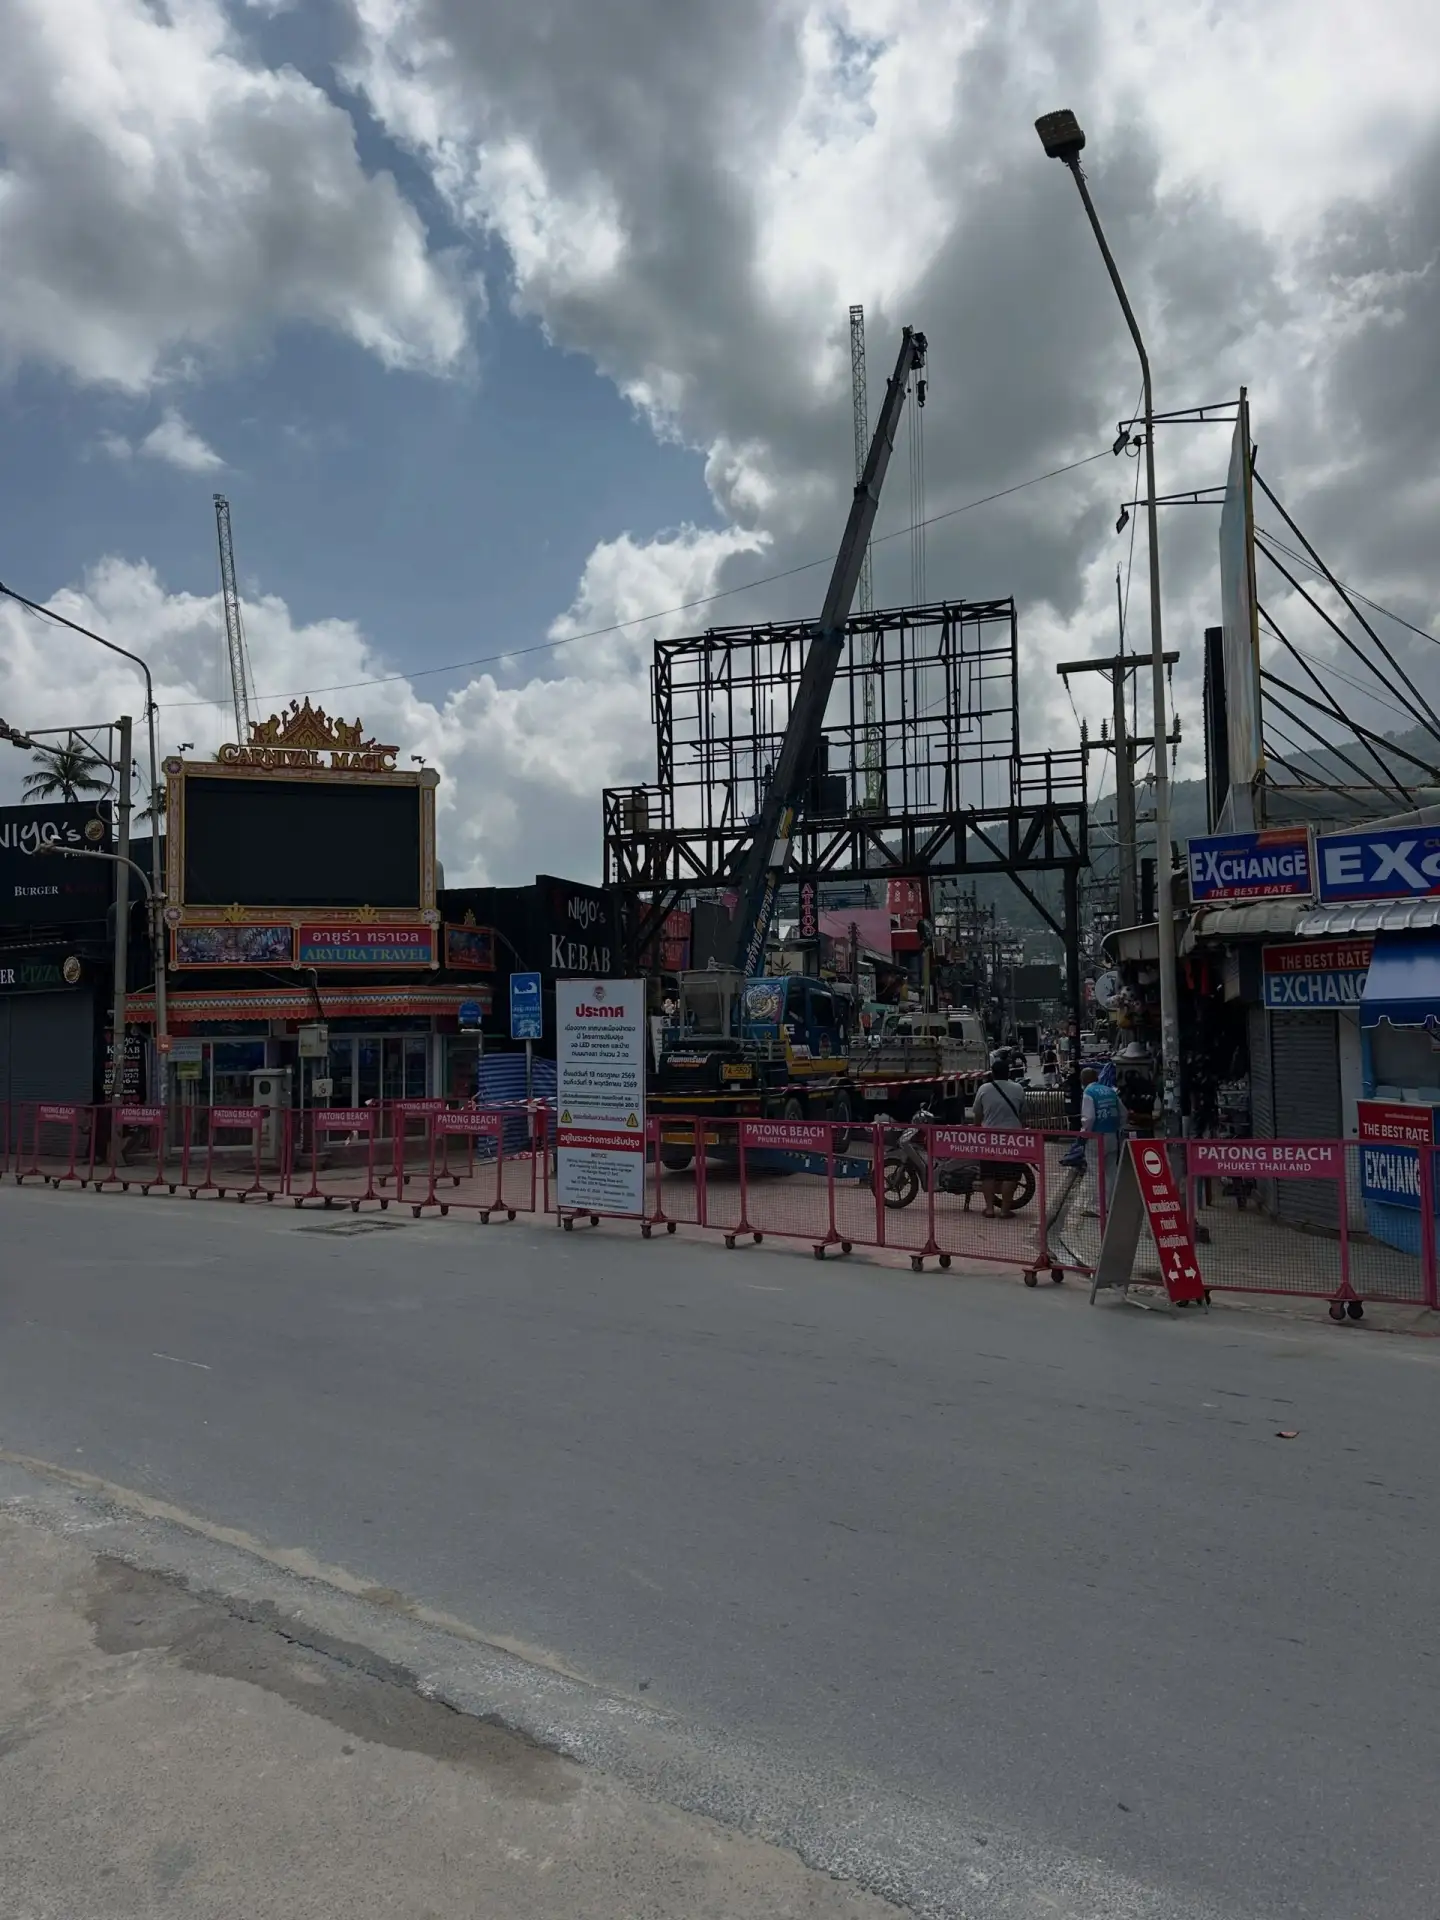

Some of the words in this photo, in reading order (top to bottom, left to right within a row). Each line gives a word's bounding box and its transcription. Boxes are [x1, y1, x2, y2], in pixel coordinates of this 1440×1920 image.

[219, 743, 324, 770] CARNIVAL
[330, 750, 397, 771] MAGIC
[1190, 851, 1307, 888] EXCHANGE
[14, 885, 59, 897] BURGER
[1210, 889, 1229, 898] THE
[1234, 887, 1260, 897] BEST
[1264, 885, 1293, 895] RATE
[801, 882, 817, 937] ATTOO
[313, 929, 360, 945] อายูร่า
[367, 932, 419, 943] ทราเวล
[305, 948, 367, 961] ARYURA
[371, 949, 428, 961] TRAVEL
[550, 933, 611, 973] KEBAB
[1279, 955, 1302, 969] THE
[1304, 952, 1334, 968] BEST
[1337, 950, 1370, 967] RATE
[575, 1003, 625, 1018] ประกาศ
[121, 1108, 140, 1116] ATONG
[318, 1111, 346, 1121] PATONG
[347, 1112, 369, 1121] BEACH
[437, 1114, 469, 1124] PATONG
[471, 1115, 498, 1125] BEACH
[746, 1124, 787, 1136] PATONG
[789, 1126, 825, 1139] BEACH
[1363, 1122, 1380, 1137] THE
[1381, 1125, 1404, 1139] BEST
[1406, 1127, 1430, 1142] RATE
[782, 1137, 813, 1145] THAILAND
[935, 1131, 986, 1144] PATONG
[990, 1133, 1035, 1148] BEACH
[950, 1144, 978, 1153] PHUKET
[980, 1146, 1019, 1156] THAILAND
[1198, 1146, 1267, 1160] PATONG
[1272, 1147, 1332, 1161] BEACH
[1217, 1162, 1257, 1170] PHUKET
[1259, 1162, 1312, 1172] THAILAND
[1364, 1151, 1421, 1197] EXCHANG
